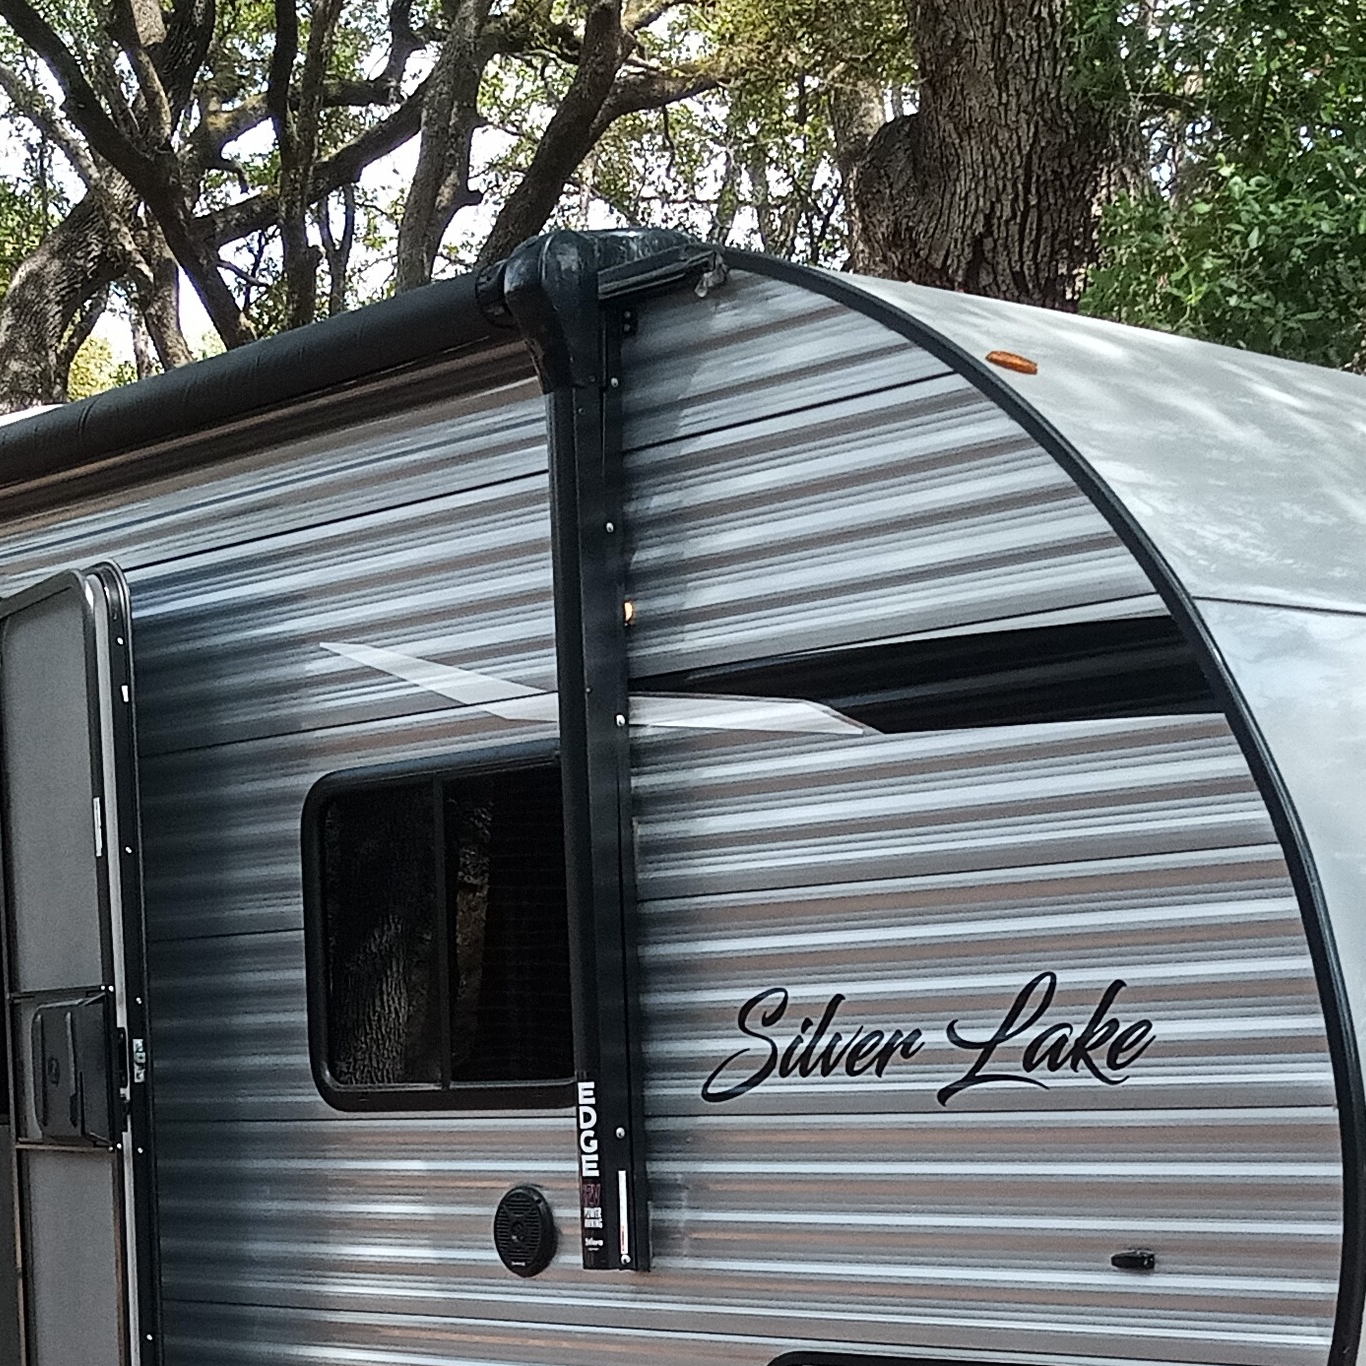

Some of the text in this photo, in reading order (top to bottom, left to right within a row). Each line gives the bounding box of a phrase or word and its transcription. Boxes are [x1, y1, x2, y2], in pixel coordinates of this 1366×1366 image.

[700, 970, 1157, 1108] Silver Lake
[577, 1081, 600, 1178] EDGE
